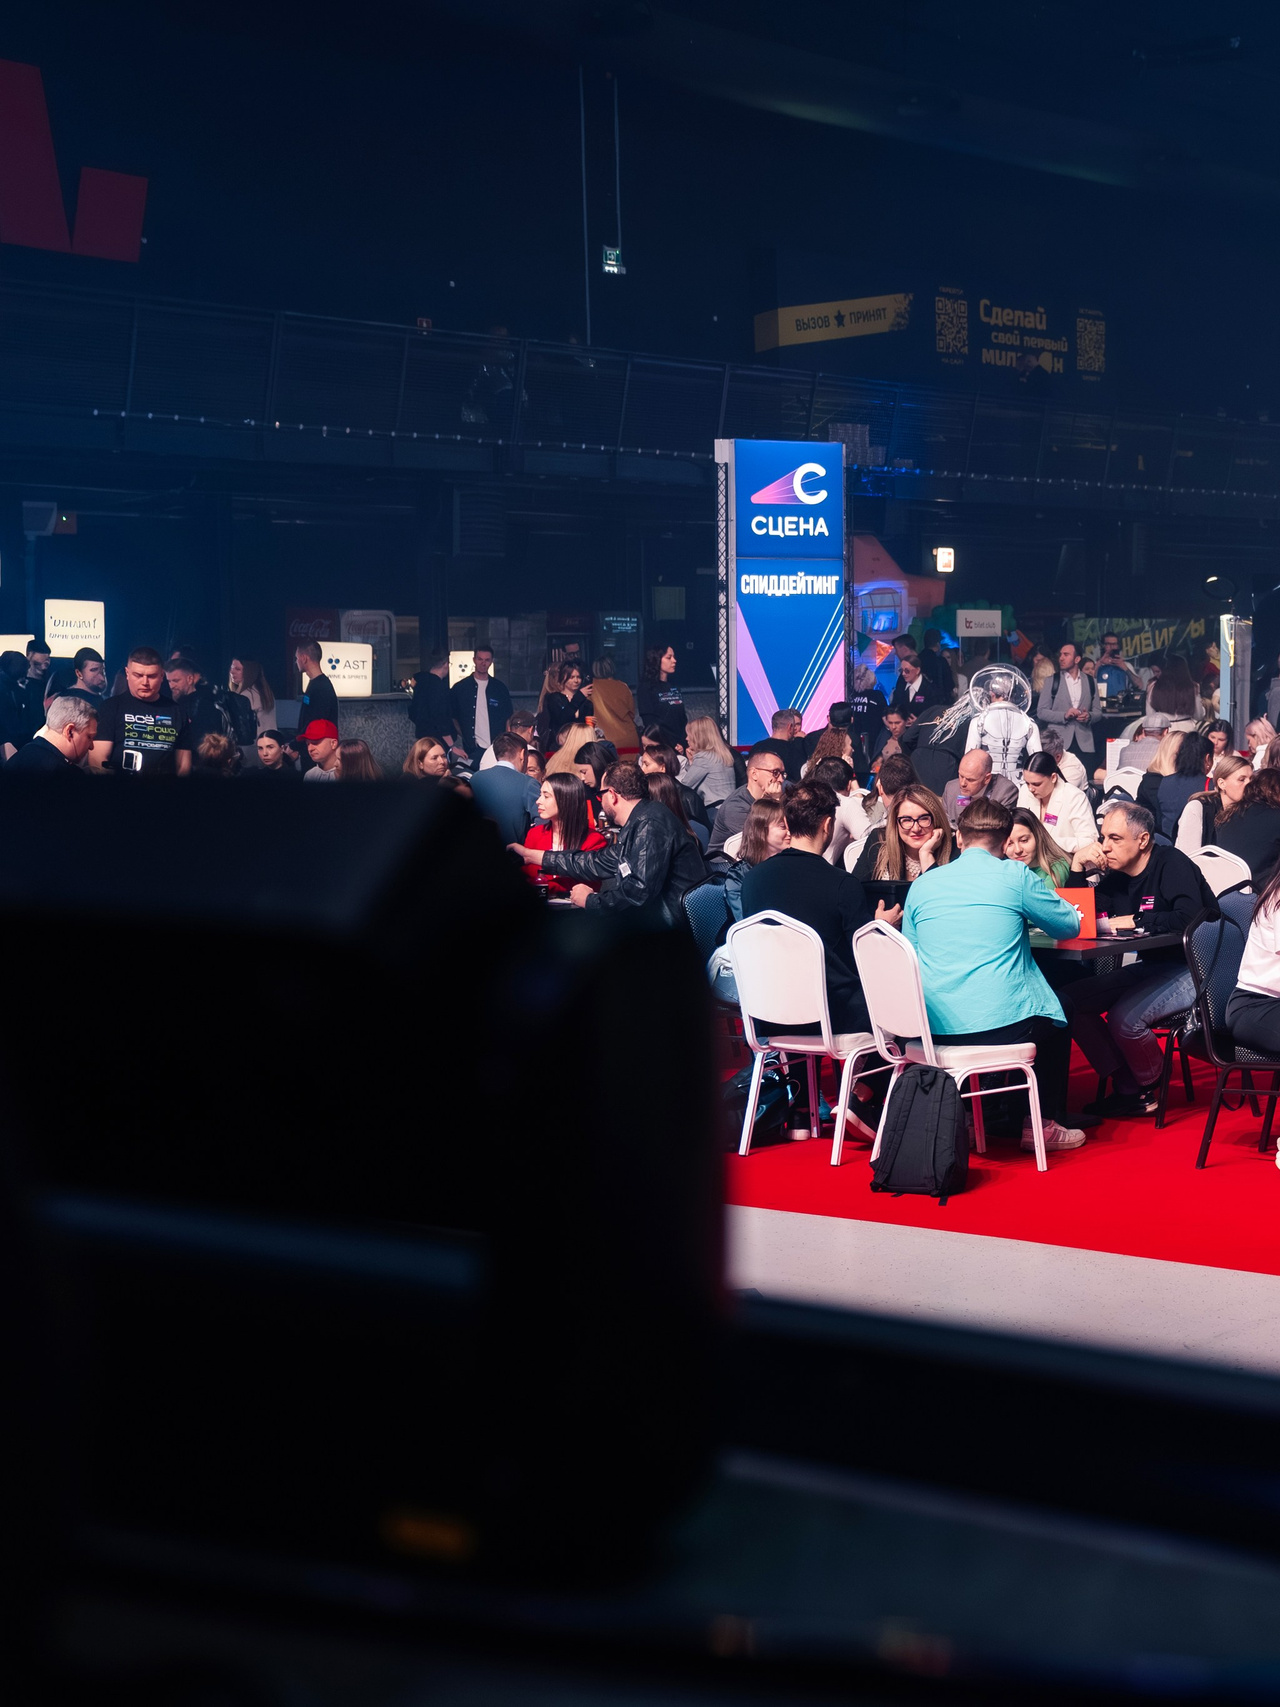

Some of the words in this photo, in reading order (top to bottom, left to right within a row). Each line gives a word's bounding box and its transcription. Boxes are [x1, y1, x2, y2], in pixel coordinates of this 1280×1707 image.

[795, 315, 831, 332] ВЫЗОВ
[849, 307, 887, 324] ПРИНЯТ
[979, 299, 1047, 331] Сделай
[991, 330, 1020, 346] свой
[1023, 335, 1068, 352] первый
[751, 515, 829, 538] СЦЕНА
[740, 571, 840, 597] СПИДДЕЙТИНГ
[343, 660, 367, 670] AST
